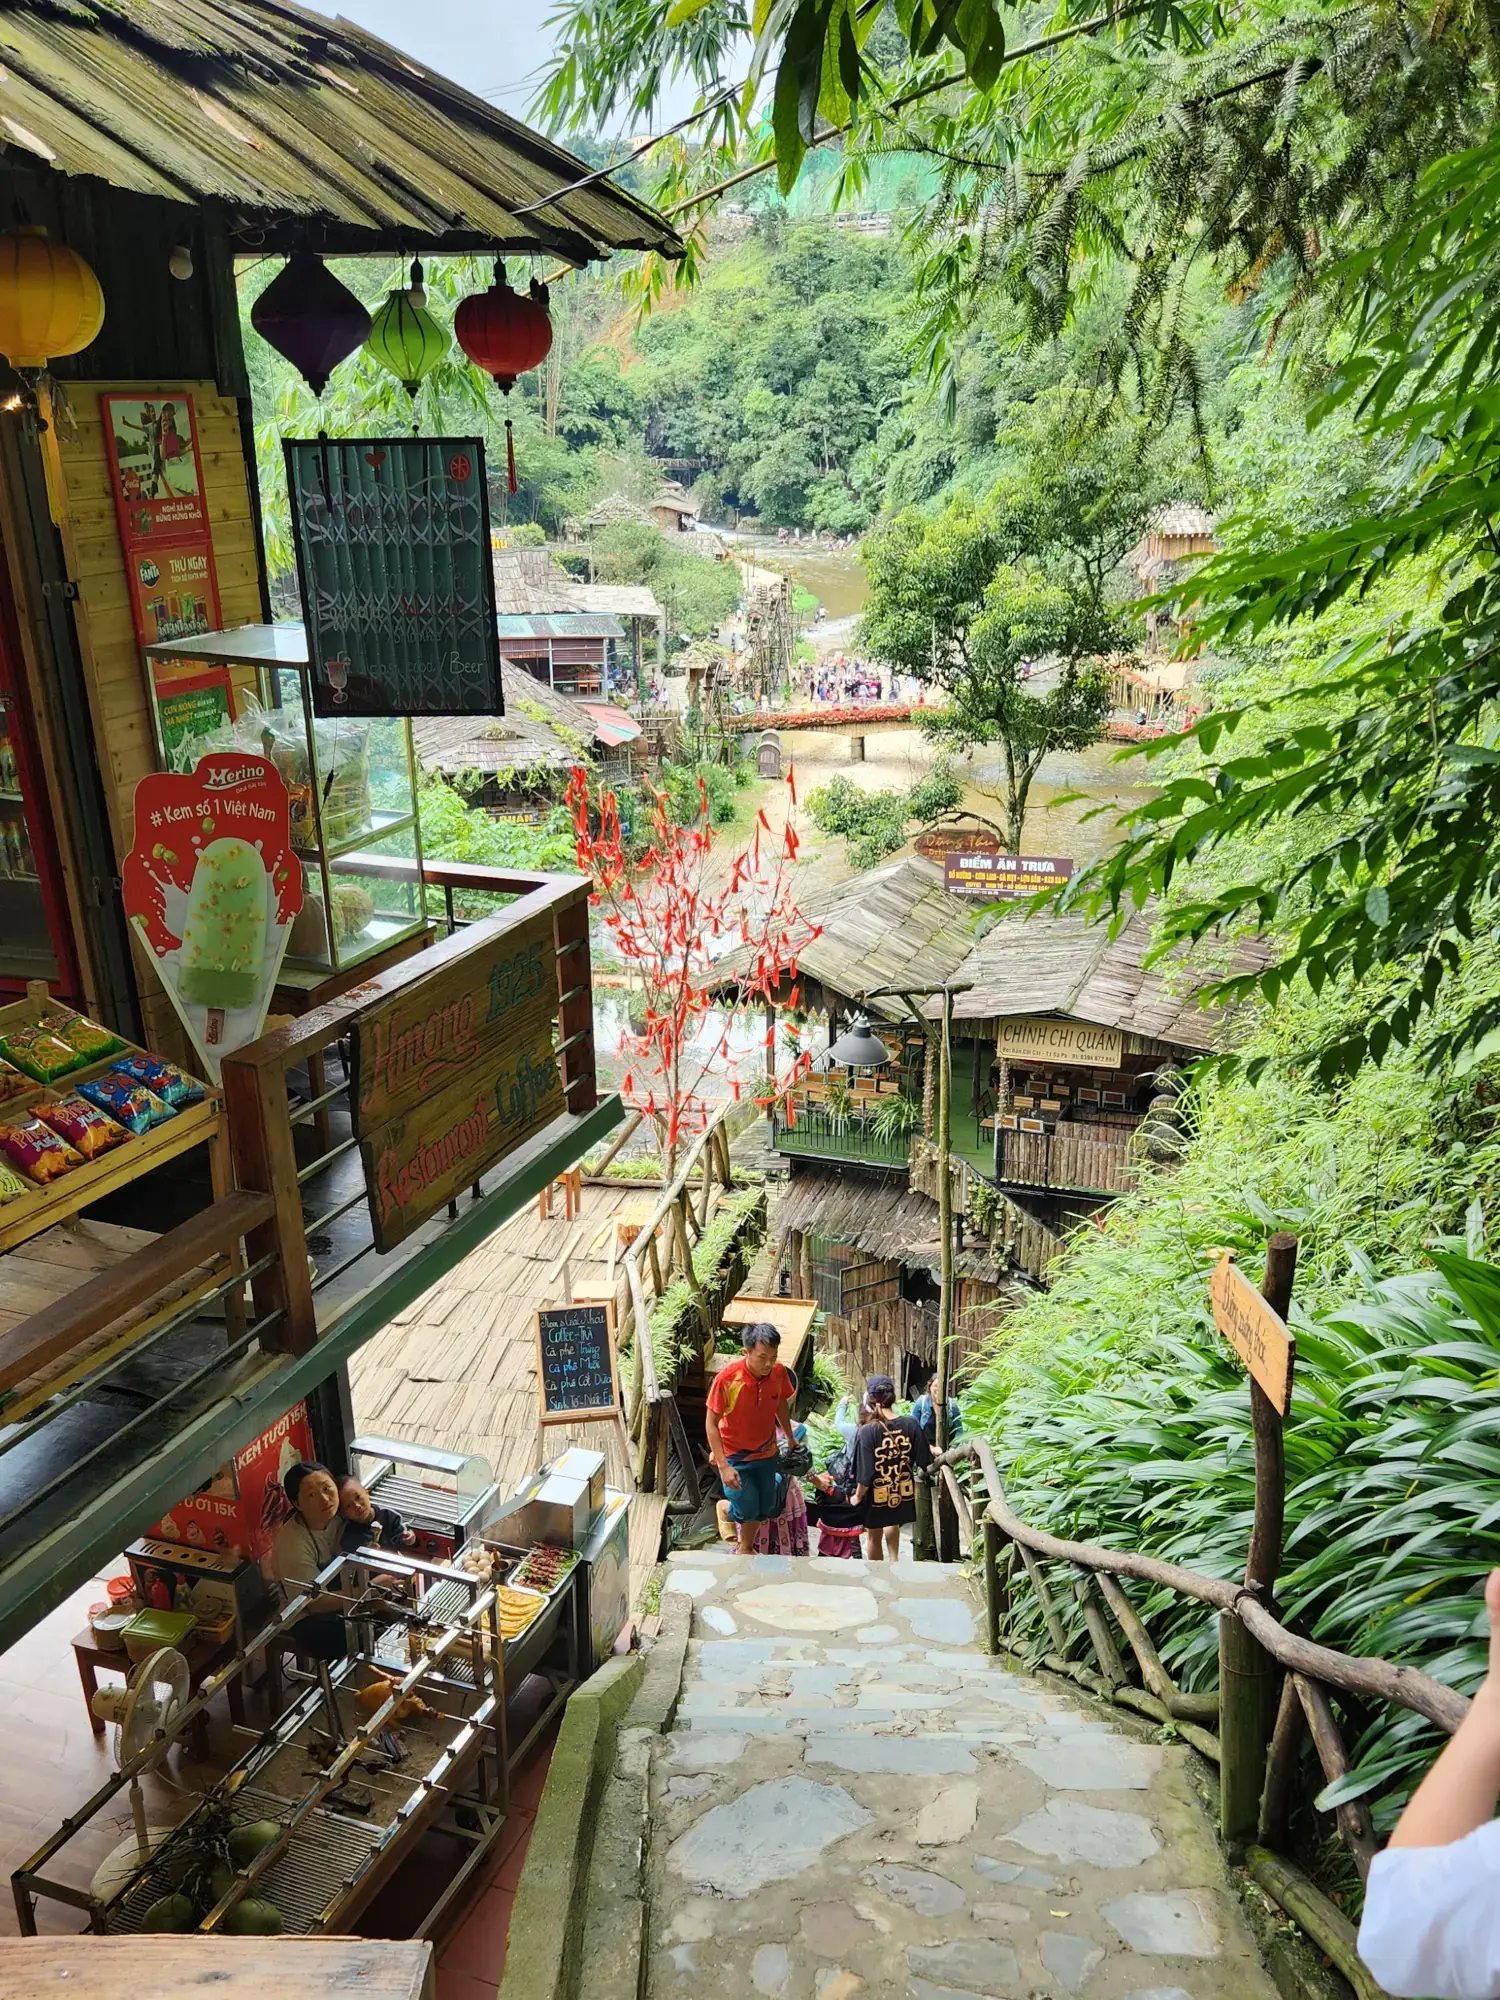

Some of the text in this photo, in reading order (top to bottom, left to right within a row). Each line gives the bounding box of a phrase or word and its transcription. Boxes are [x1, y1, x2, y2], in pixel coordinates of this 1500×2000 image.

[187, 555, 207, 570] NGAY
[140, 564, 160, 582] FANTA
[450, 650, 483, 675] Beer
[207, 764, 265, 785] Merino
[164, 805, 193, 824] Kem
[194, 798, 211, 817] số
[214, 798, 221, 815] 1
[223, 800, 246, 819] Việt
[249, 803, 276, 822] Nam
[959, 855, 1055, 872] ĐIỂM ĂN TRƯA
[1049, 1028, 1074, 1048] CHI
[1076, 1028, 1118, 1052] QUÁN
[378, 1047, 558, 1225] Restaurant Coffee
[560, 1343, 576, 1360] phê
[548, 1363, 561, 1373] Cà
[563, 1358, 578, 1376] phê
[544, 1379, 558, 1391] Cà
[560, 1376, 576, 1395] phê
[238, 1401, 307, 1470] KEM TƯƠI 15K
[213, 1501, 238, 1518] 15K
